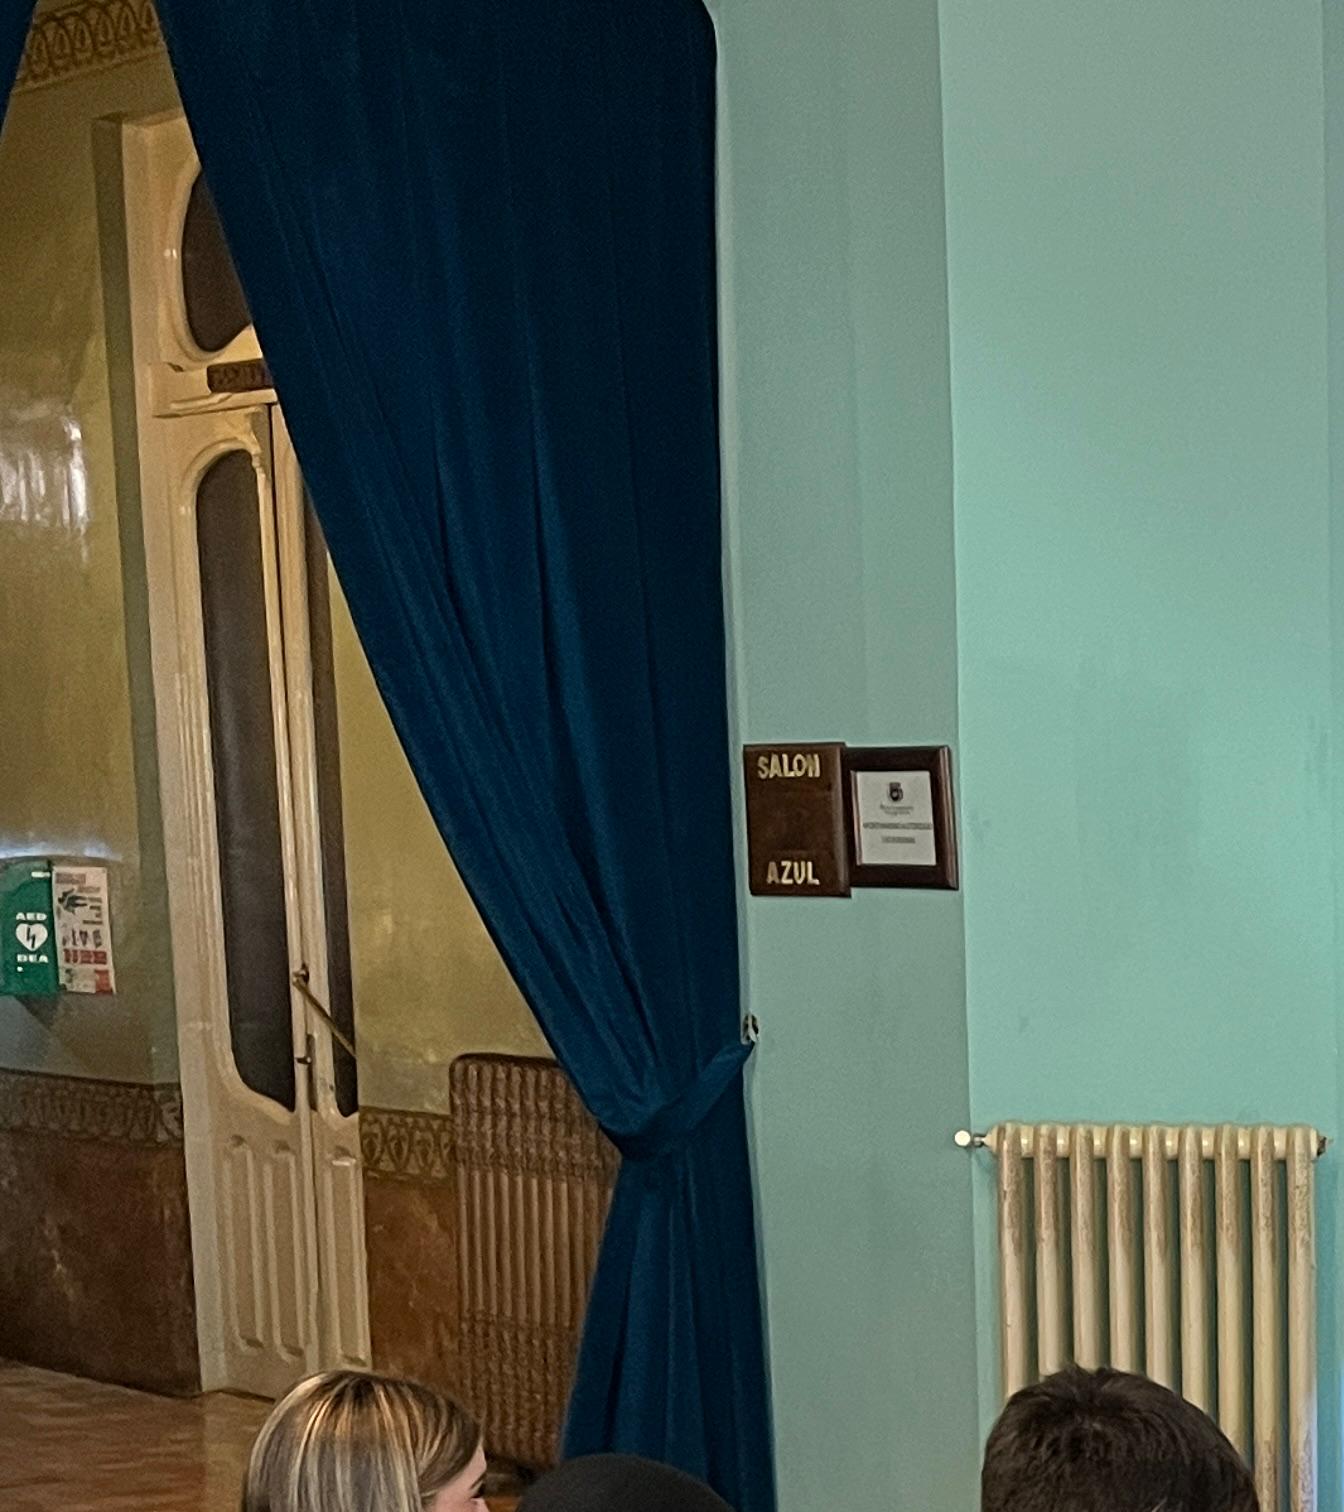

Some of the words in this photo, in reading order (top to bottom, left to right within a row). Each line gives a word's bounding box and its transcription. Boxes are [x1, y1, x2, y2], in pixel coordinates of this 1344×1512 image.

[757, 753, 821, 779] SALON
[766, 860, 820, 885] AZUL
[15, 911, 48, 921] AED
[16, 953, 49, 963] DEA
